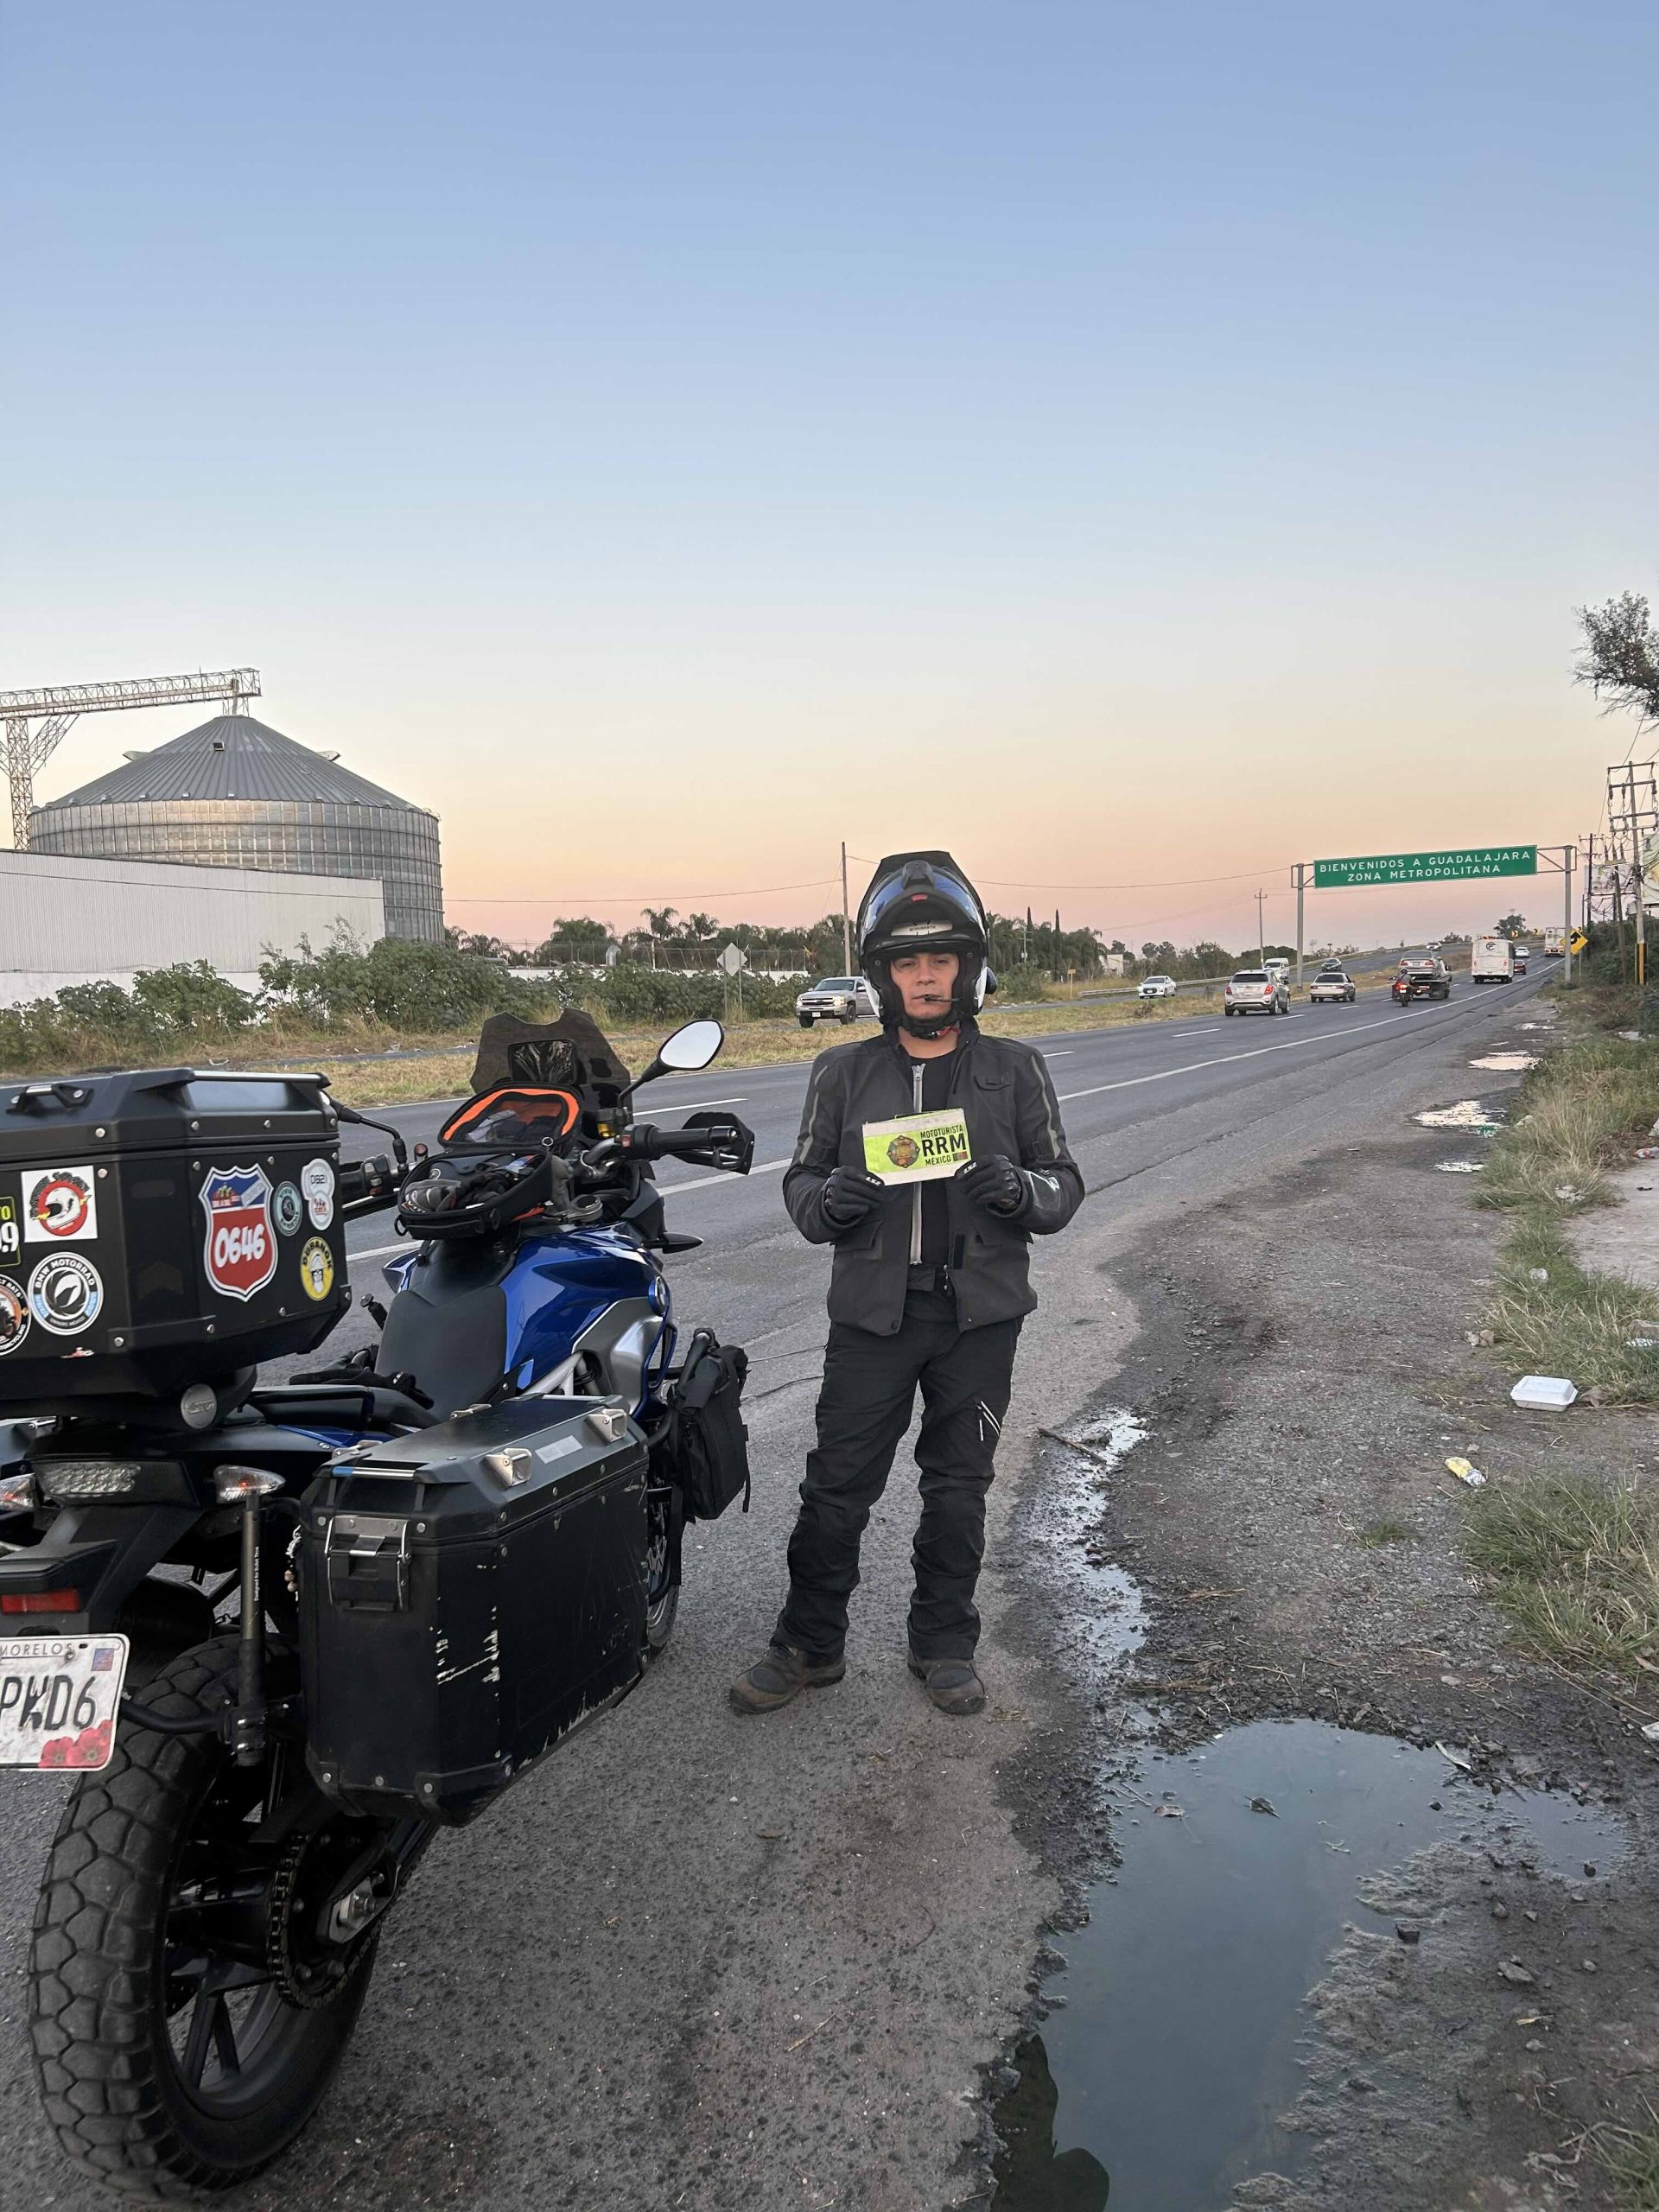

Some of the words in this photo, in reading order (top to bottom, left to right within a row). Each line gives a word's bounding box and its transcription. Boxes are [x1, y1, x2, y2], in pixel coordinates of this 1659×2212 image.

[1319, 859, 1405, 874] BIENVENIDOS
[1413, 858, 1421, 867] A
[1428, 850, 1530, 865] GUADALAJARA
[1347, 872, 1382, 882] ZONA
[1389, 864, 1501, 880] METROPOLITANA
[920, 1124, 964, 1139] MOTOTURISTA
[921, 1133, 967, 1157] RRM
[214, 1223, 266, 1268] 0646
[35, 1265, 50, 1288] BMW
[50, 1258, 95, 1286] MOTORRAD
[0, 1643, 73, 1657] MORELOS
